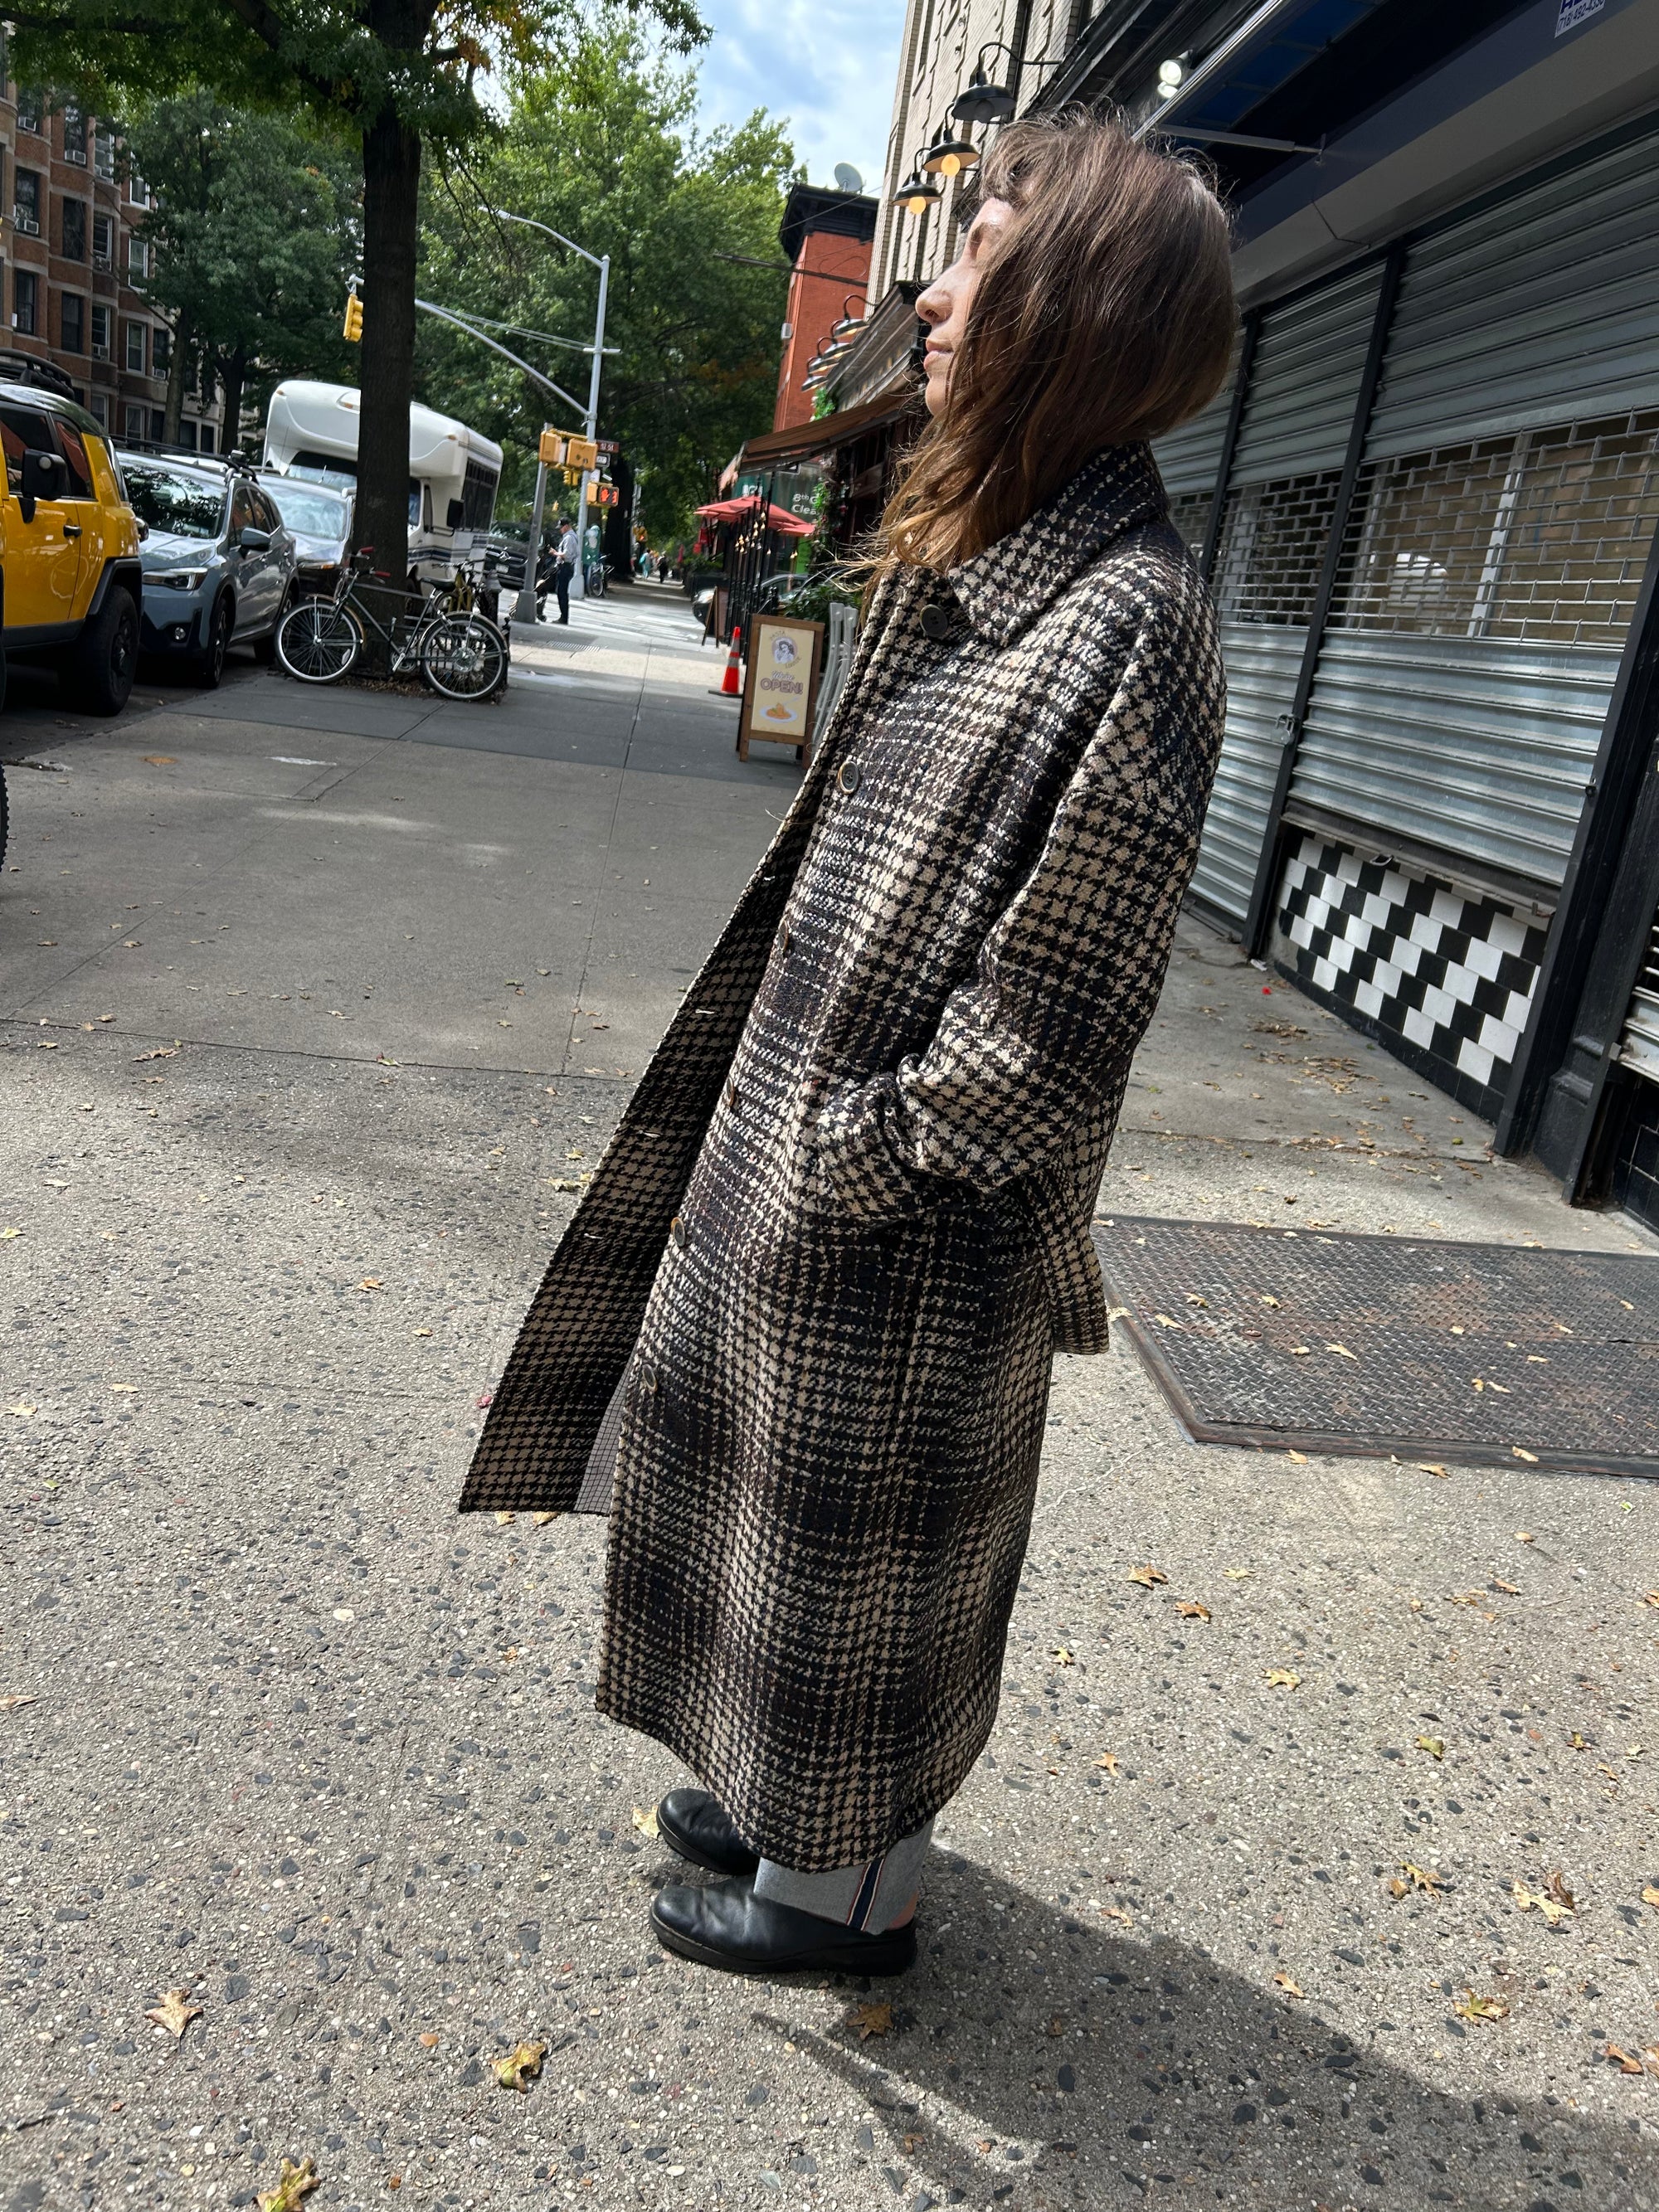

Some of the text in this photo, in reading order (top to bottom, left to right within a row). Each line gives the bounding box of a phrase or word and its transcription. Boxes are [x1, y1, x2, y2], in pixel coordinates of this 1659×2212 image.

[792, 493, 810, 502] 8th
[791, 504, 820, 515] Clea
[760, 678, 804, 694] OPEN!
